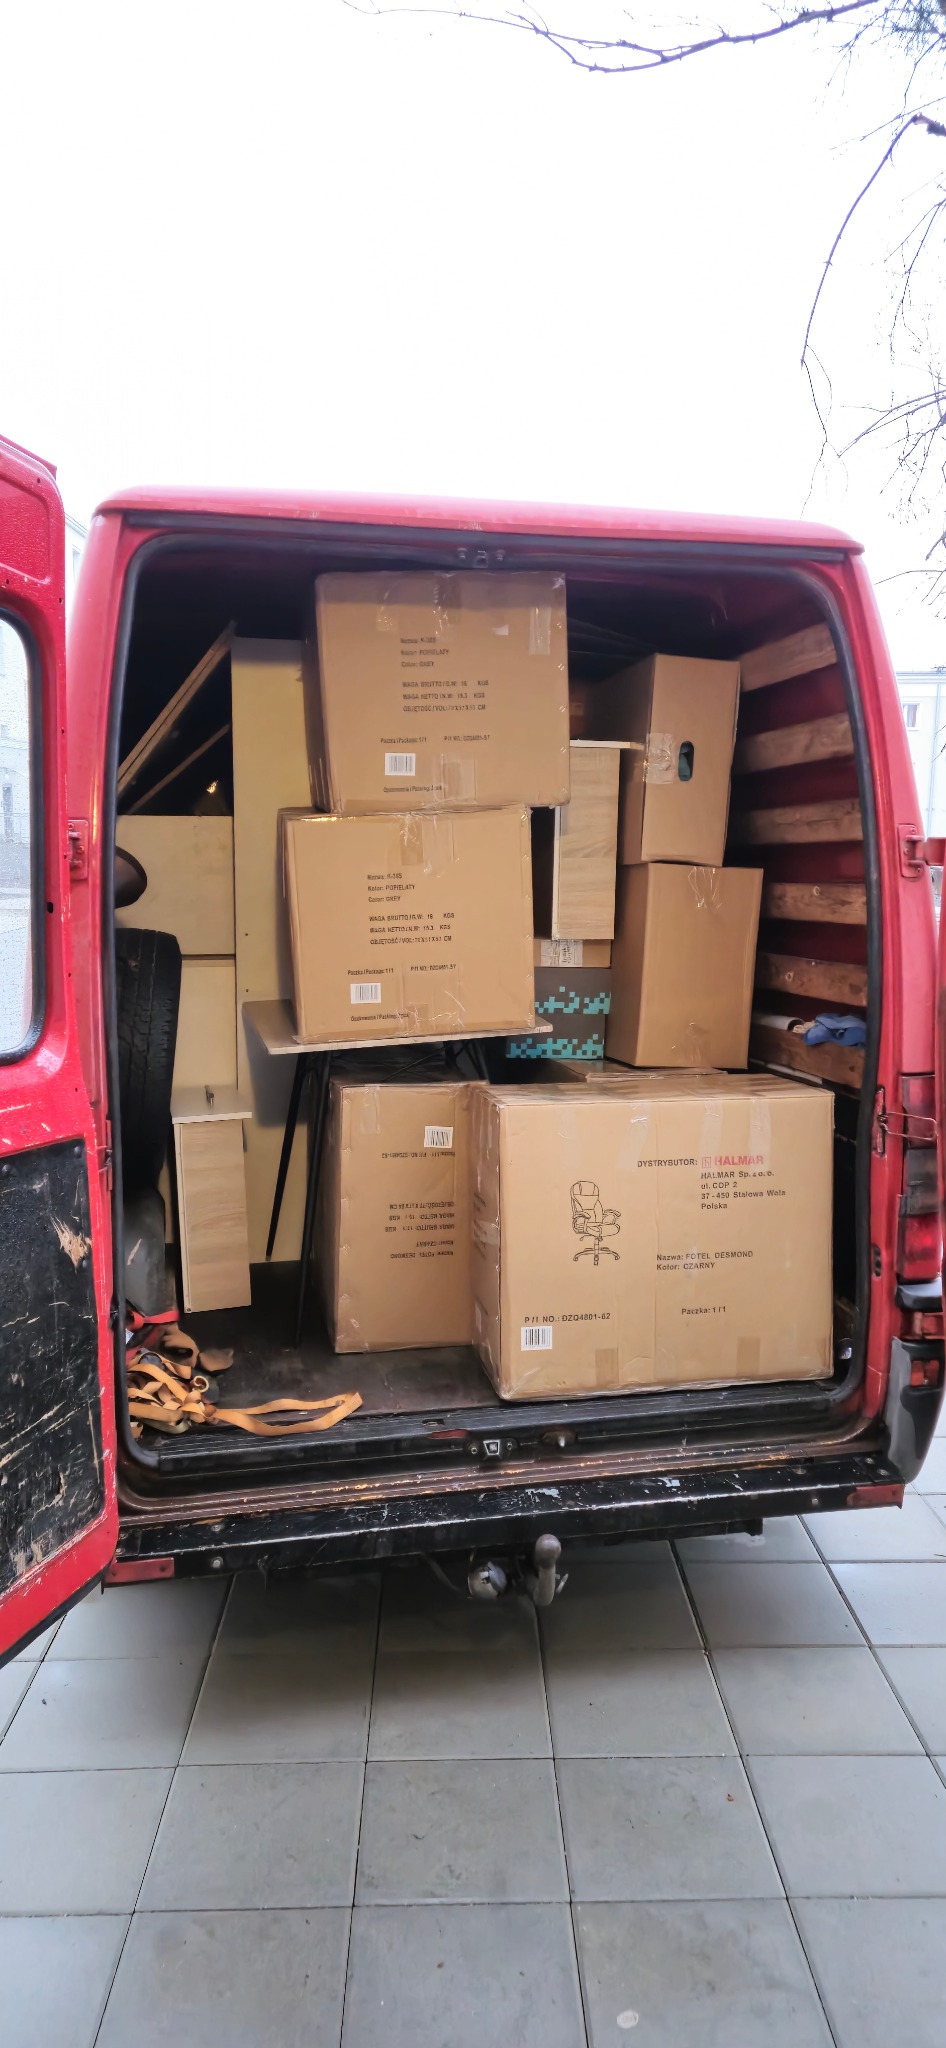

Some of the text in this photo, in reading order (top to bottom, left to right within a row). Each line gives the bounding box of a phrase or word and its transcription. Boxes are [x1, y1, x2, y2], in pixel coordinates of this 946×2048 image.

[637, 1159, 698, 1168] DYSTRYBUTOR:
[715, 1156, 764, 1166] HALMAR
[701, 1172, 735, 1180] HALMAR
[685, 1252, 710, 1260] FOTEL
[715, 1250, 753, 1259] DESMOND
[683, 1262, 715, 1270] CZARNY
